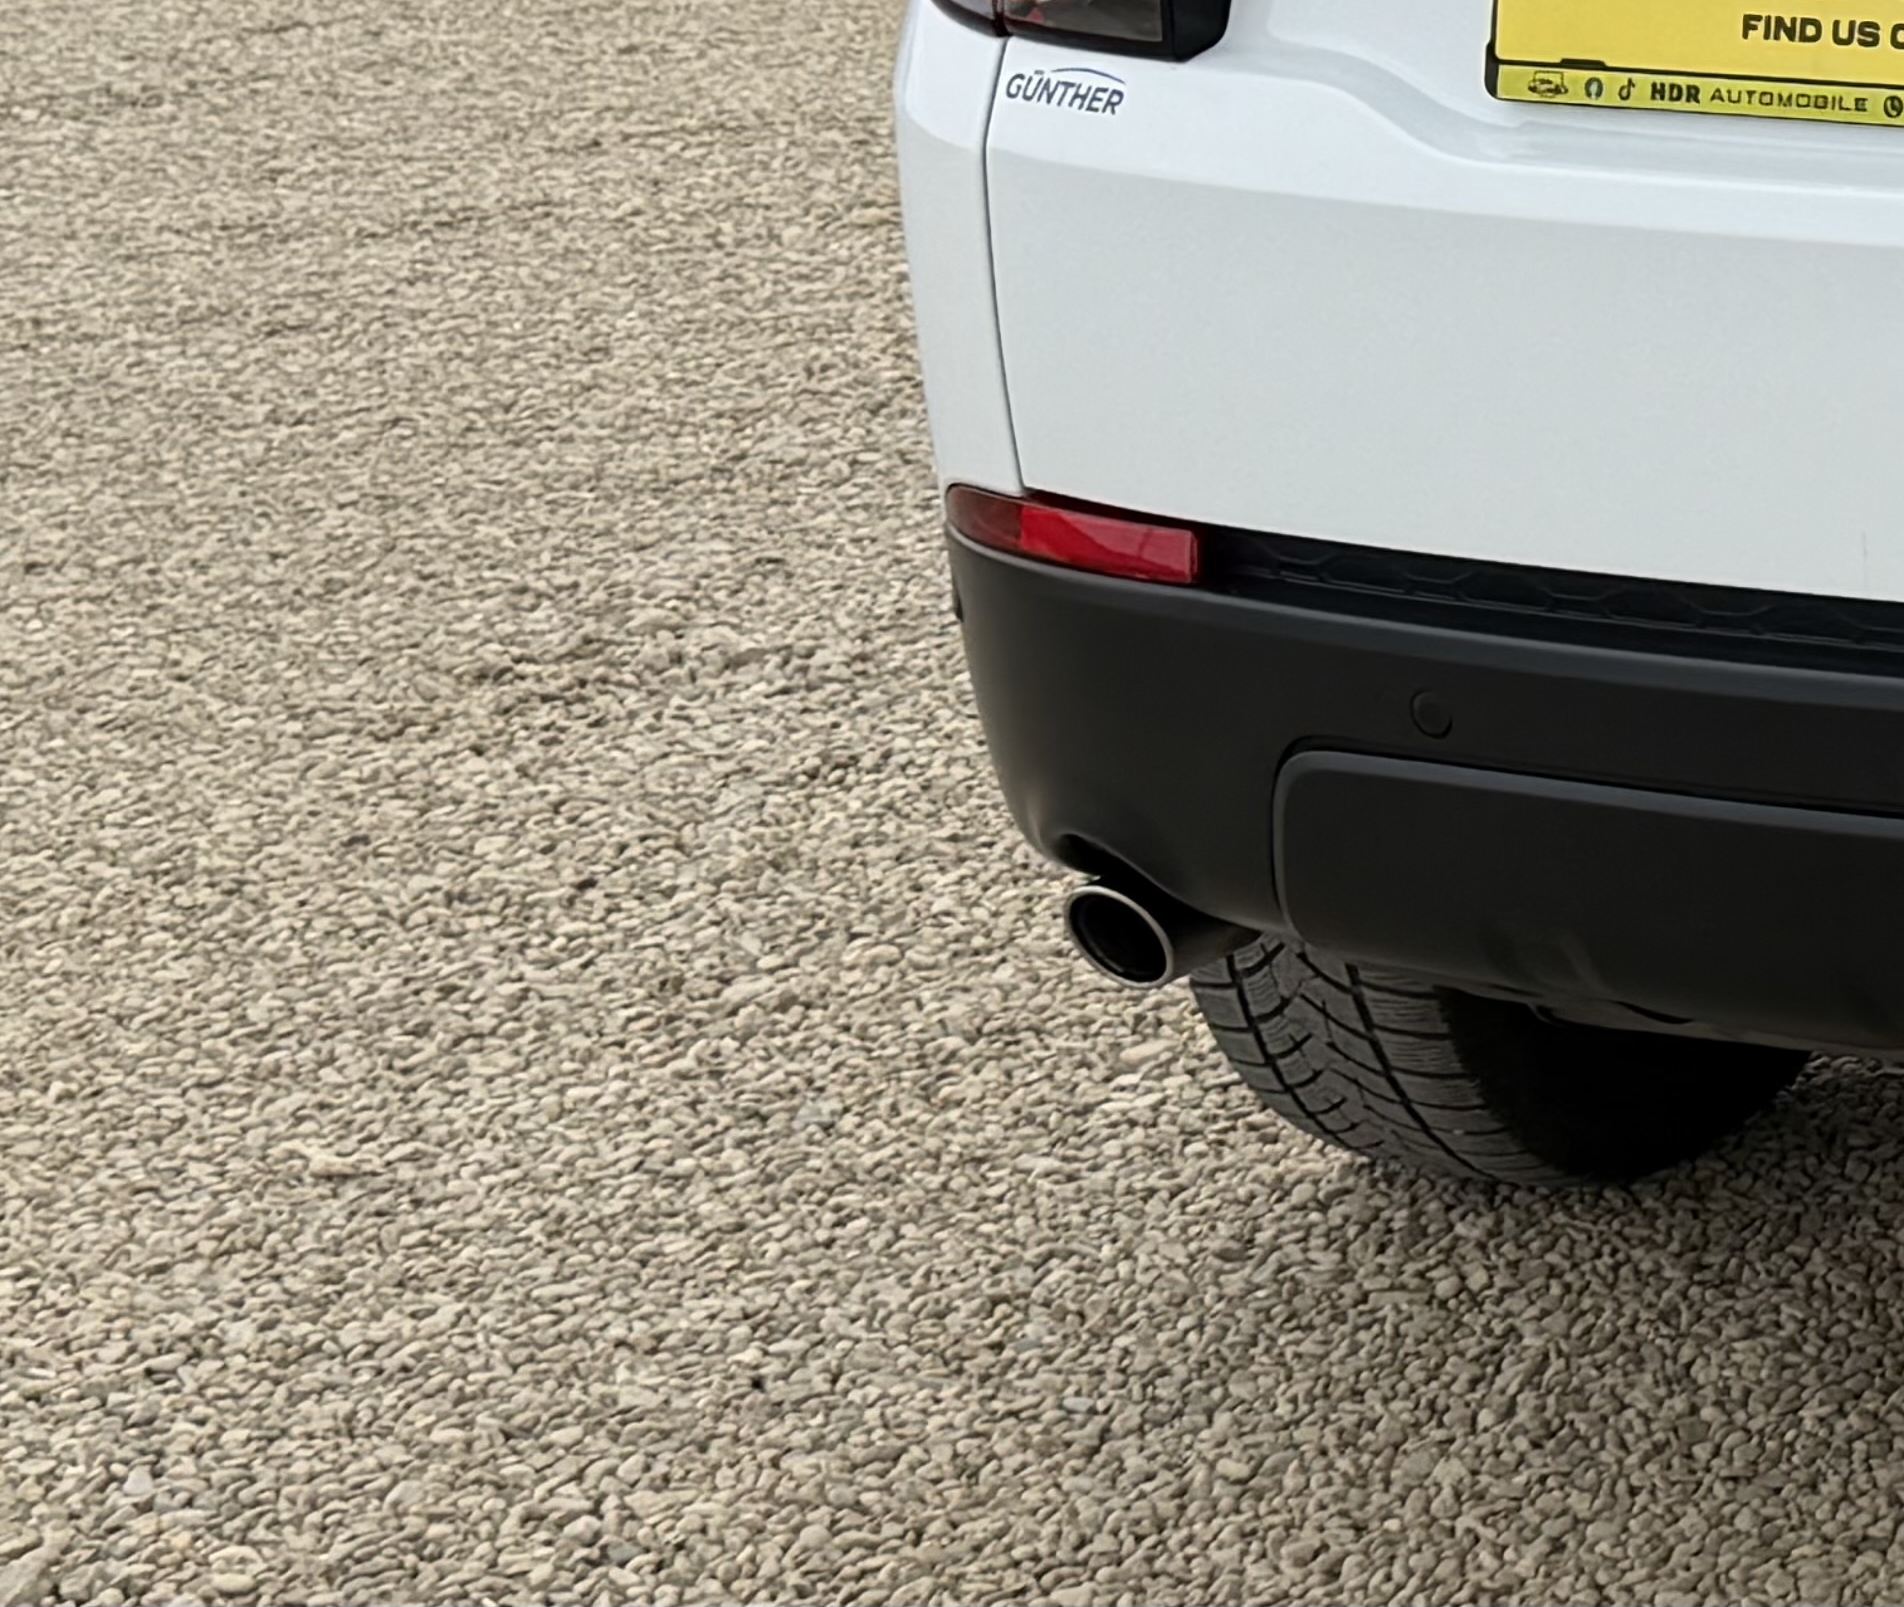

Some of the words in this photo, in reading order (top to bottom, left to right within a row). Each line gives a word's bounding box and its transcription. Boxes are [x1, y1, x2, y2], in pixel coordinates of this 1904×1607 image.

[1742, 14, 1824, 43] FIND
[1832, 20, 1881, 48] US
[1005, 69, 1125, 115] GÜNTHER
[1650, 81, 1701, 105] HDR
[1710, 86, 1869, 113] AUTOMOBILE
